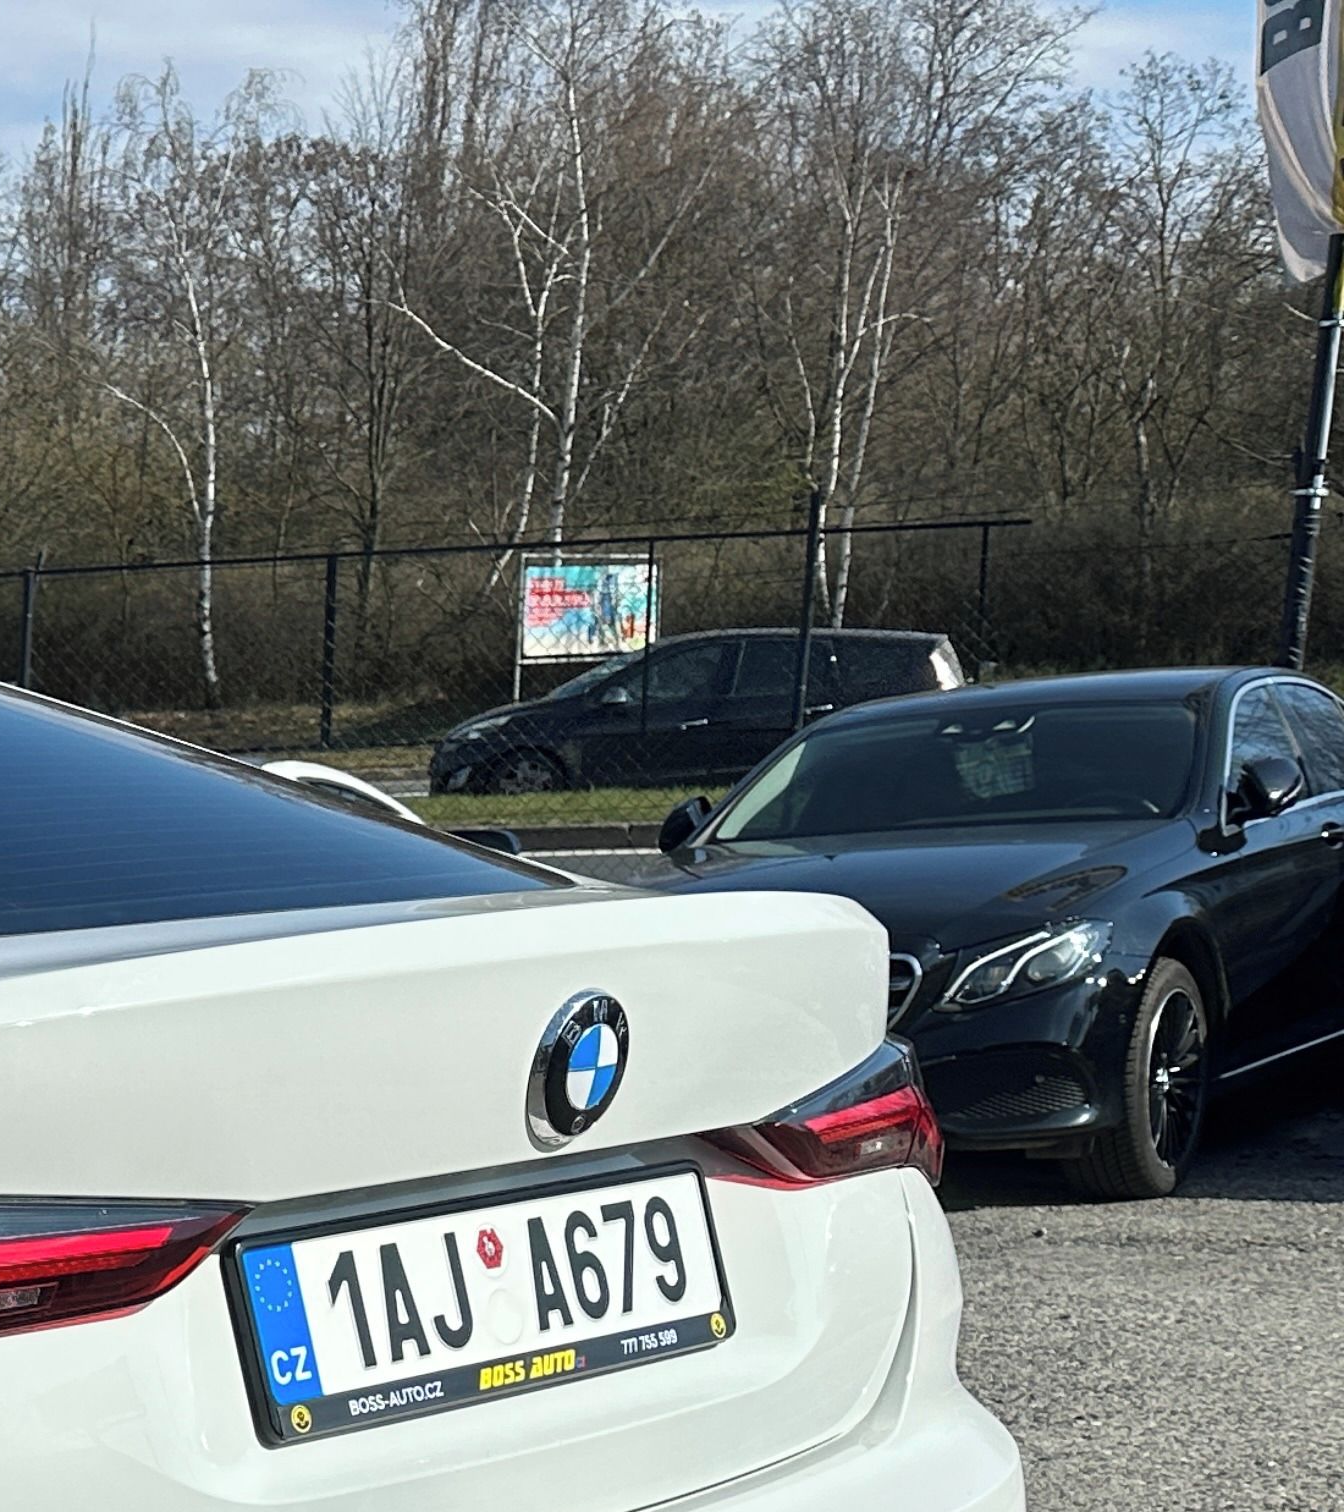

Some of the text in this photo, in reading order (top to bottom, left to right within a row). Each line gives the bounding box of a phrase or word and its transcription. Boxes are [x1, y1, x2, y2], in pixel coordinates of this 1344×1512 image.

[328, 1196, 687, 1368] 1AJ A679
[620, 1328, 678, 1355] 777 755 599
[270, 1345, 312, 1385] CZ
[479, 1360, 525, 1390] BOSS
[529, 1349, 576, 1379] AUTO
[348, 1381, 444, 1416] BOSS-AUTO.CZ
